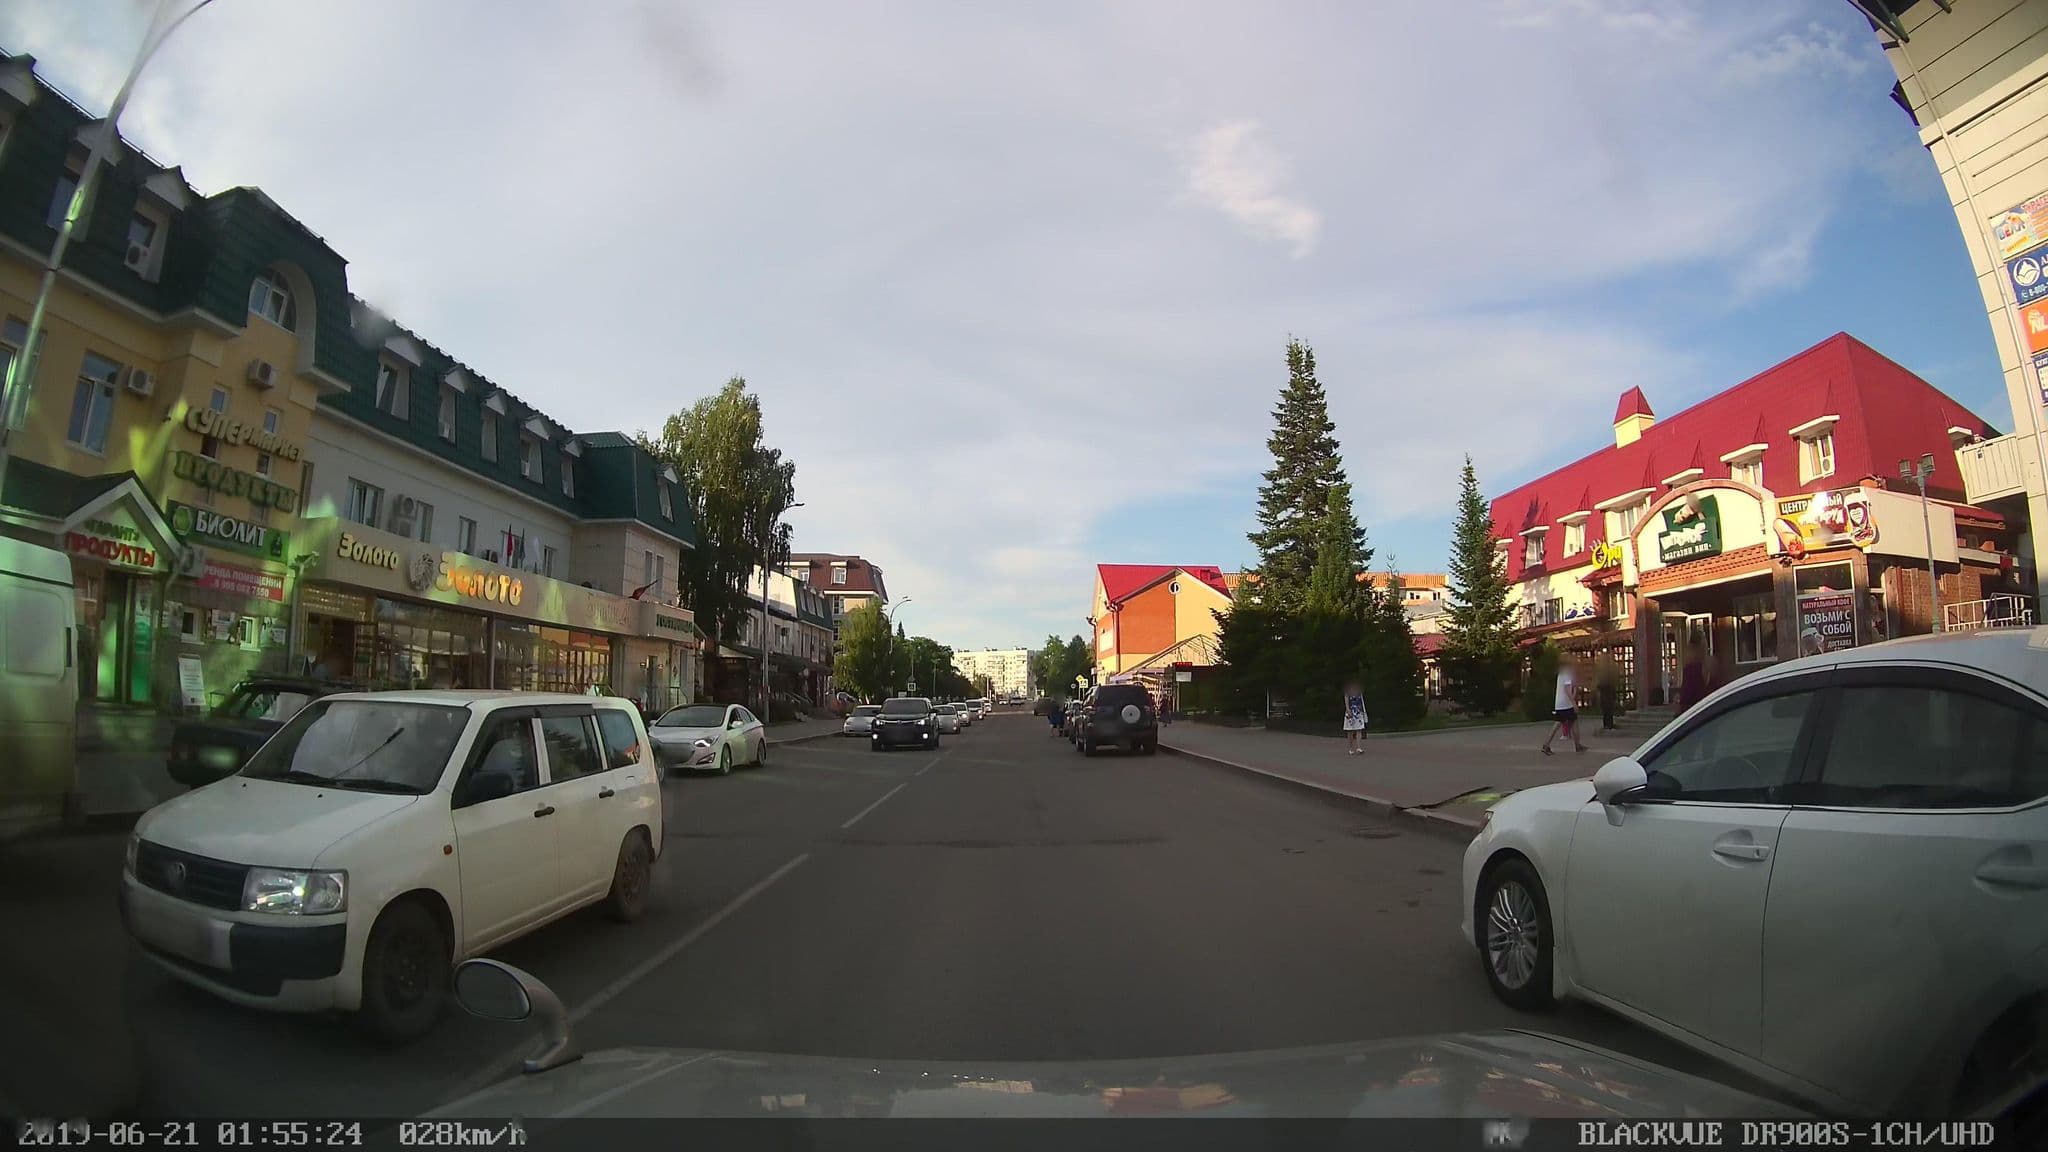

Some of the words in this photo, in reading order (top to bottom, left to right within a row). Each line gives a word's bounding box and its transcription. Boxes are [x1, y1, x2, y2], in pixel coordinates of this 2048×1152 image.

[196, 510, 268, 548] БИОЛИТ
[65, 530, 156, 568] ПРОДУКТЫ
[338, 533, 400, 570] Золото
[436, 552, 524, 606] Золото
[1804, 610, 1843, 624] ВОЗЬМИ
[1844, 609, 1851, 620] С
[1823, 621, 1852, 635] СОБОЙ
